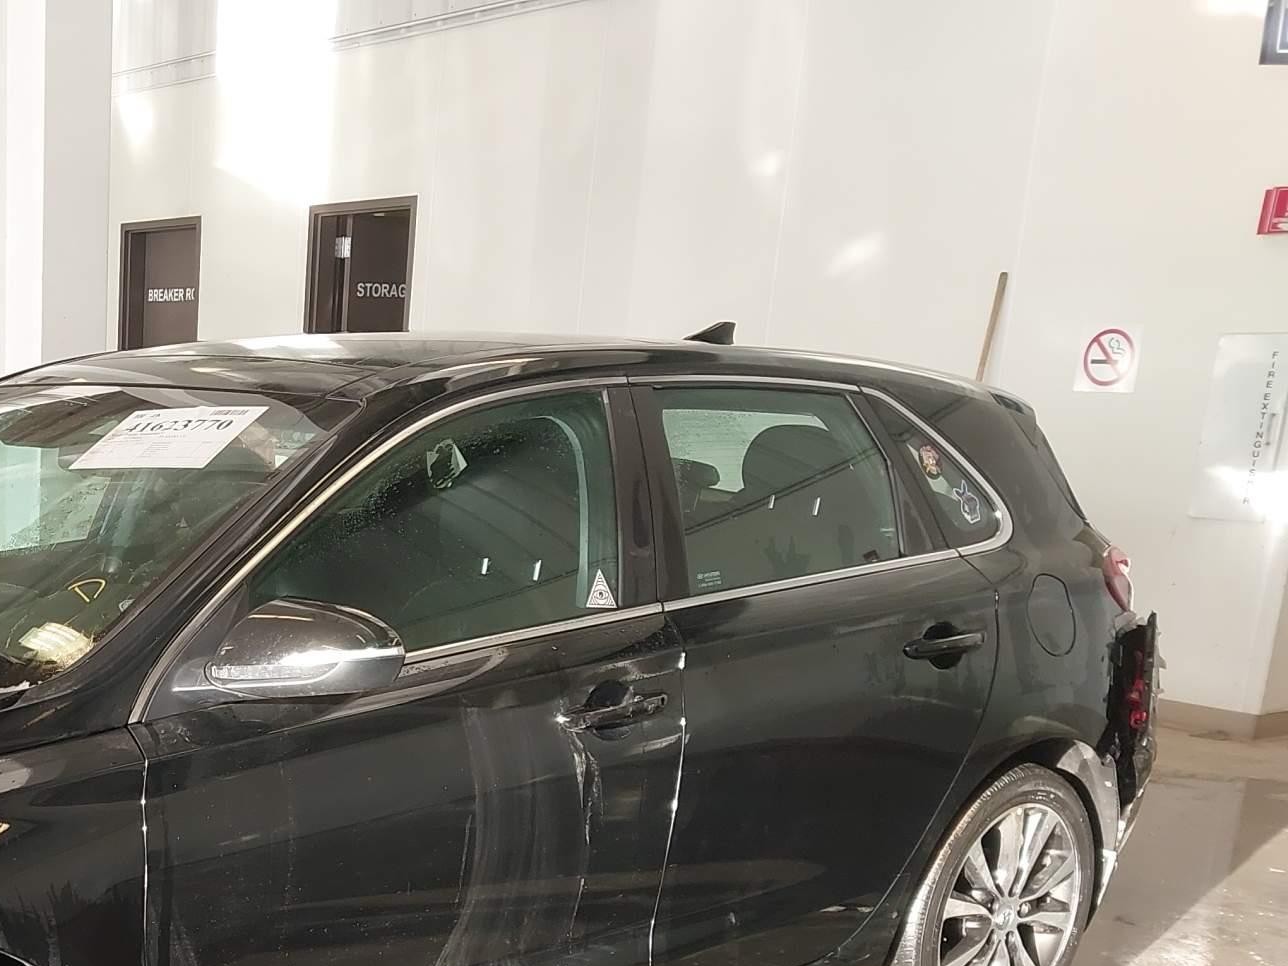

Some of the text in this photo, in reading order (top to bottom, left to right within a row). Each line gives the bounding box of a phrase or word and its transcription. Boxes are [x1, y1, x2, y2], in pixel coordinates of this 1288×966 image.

[148, 288, 184, 302] BREAKER
[356, 282, 407, 298] STORAG
[1265, 351, 1279, 389] FIRE
[125, 419, 234, 433] 41623770
